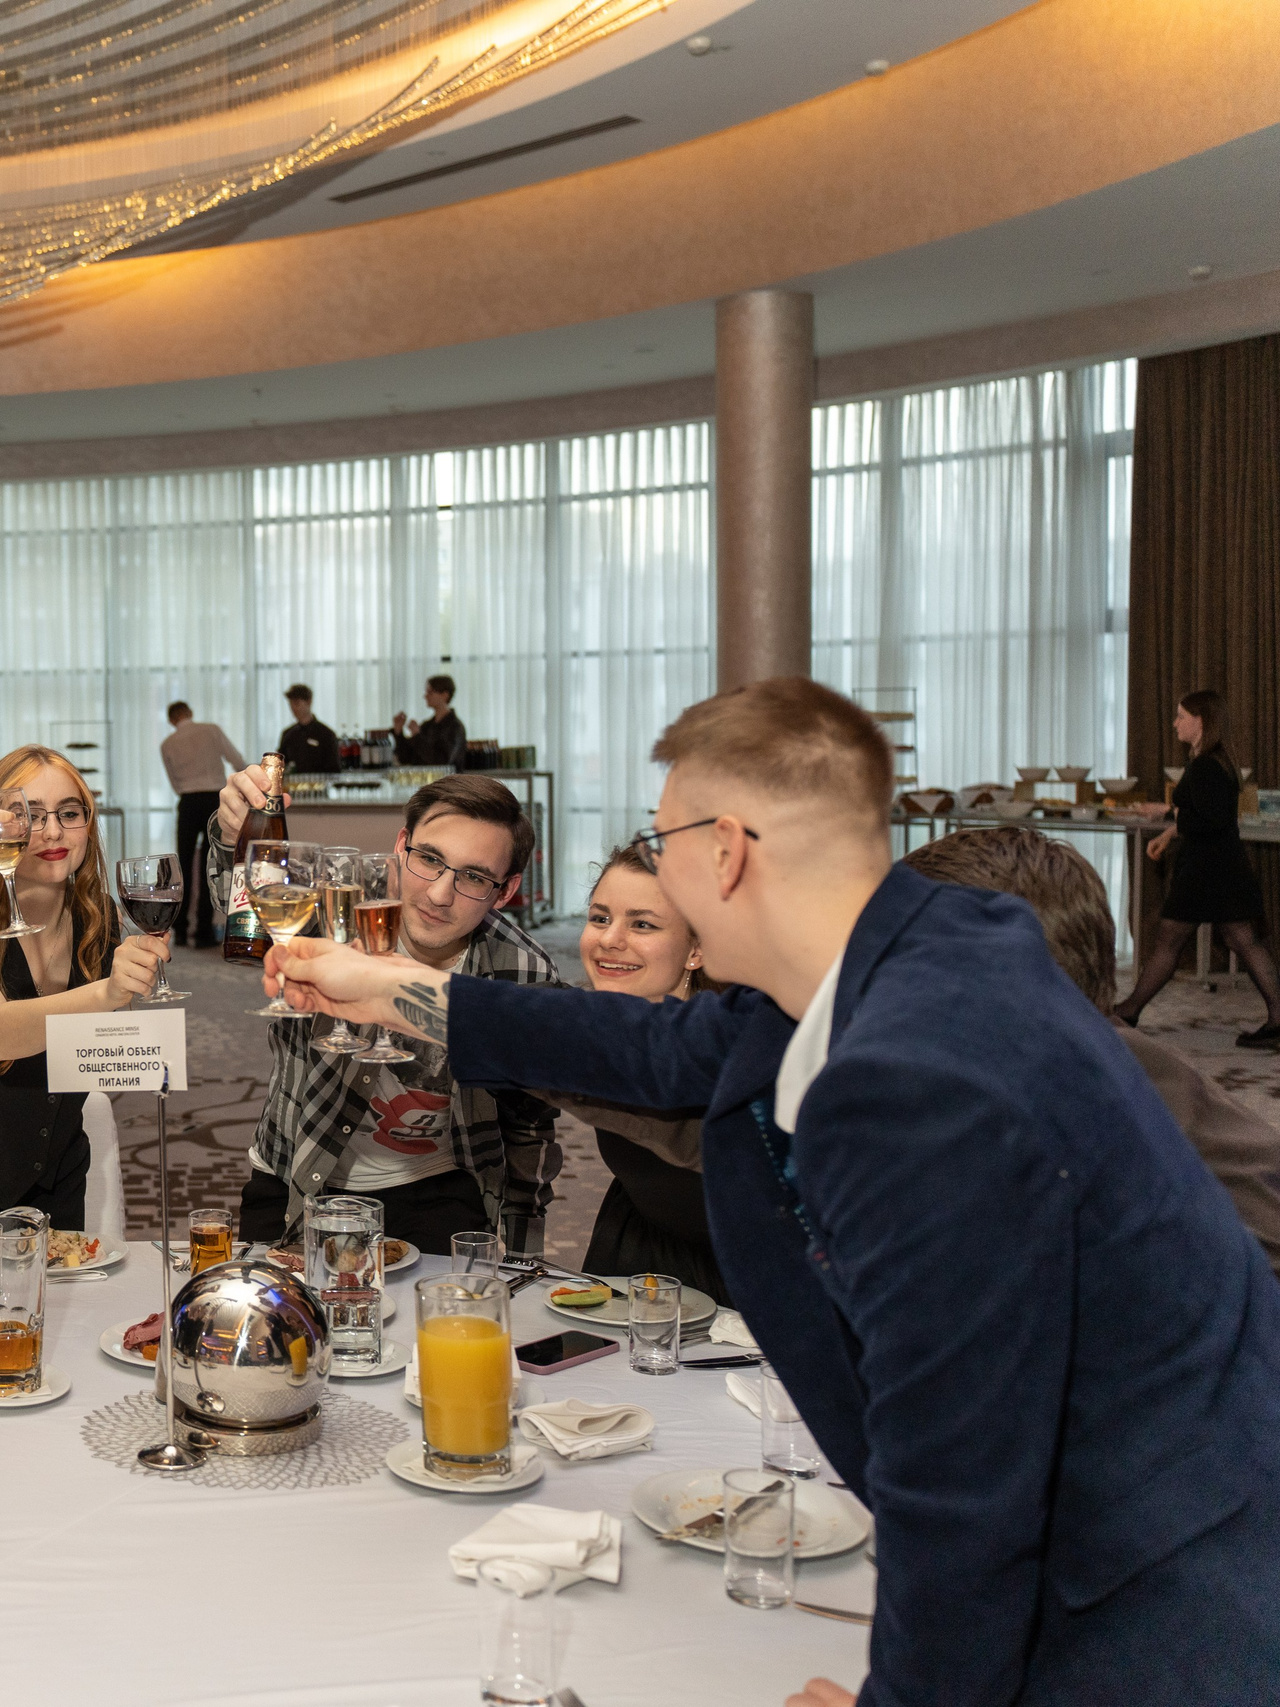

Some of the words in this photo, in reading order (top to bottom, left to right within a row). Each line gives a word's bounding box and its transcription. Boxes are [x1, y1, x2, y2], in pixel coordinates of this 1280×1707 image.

[76, 1045, 124, 1058] ТОРГОВЫЙ
[126, 1046, 161, 1057] ОБЪЕКТ
[78, 1061, 160, 1073] ОБЩЕСТВЕННОГО
[98, 1077, 141, 1087] ПИТАНИЯ
